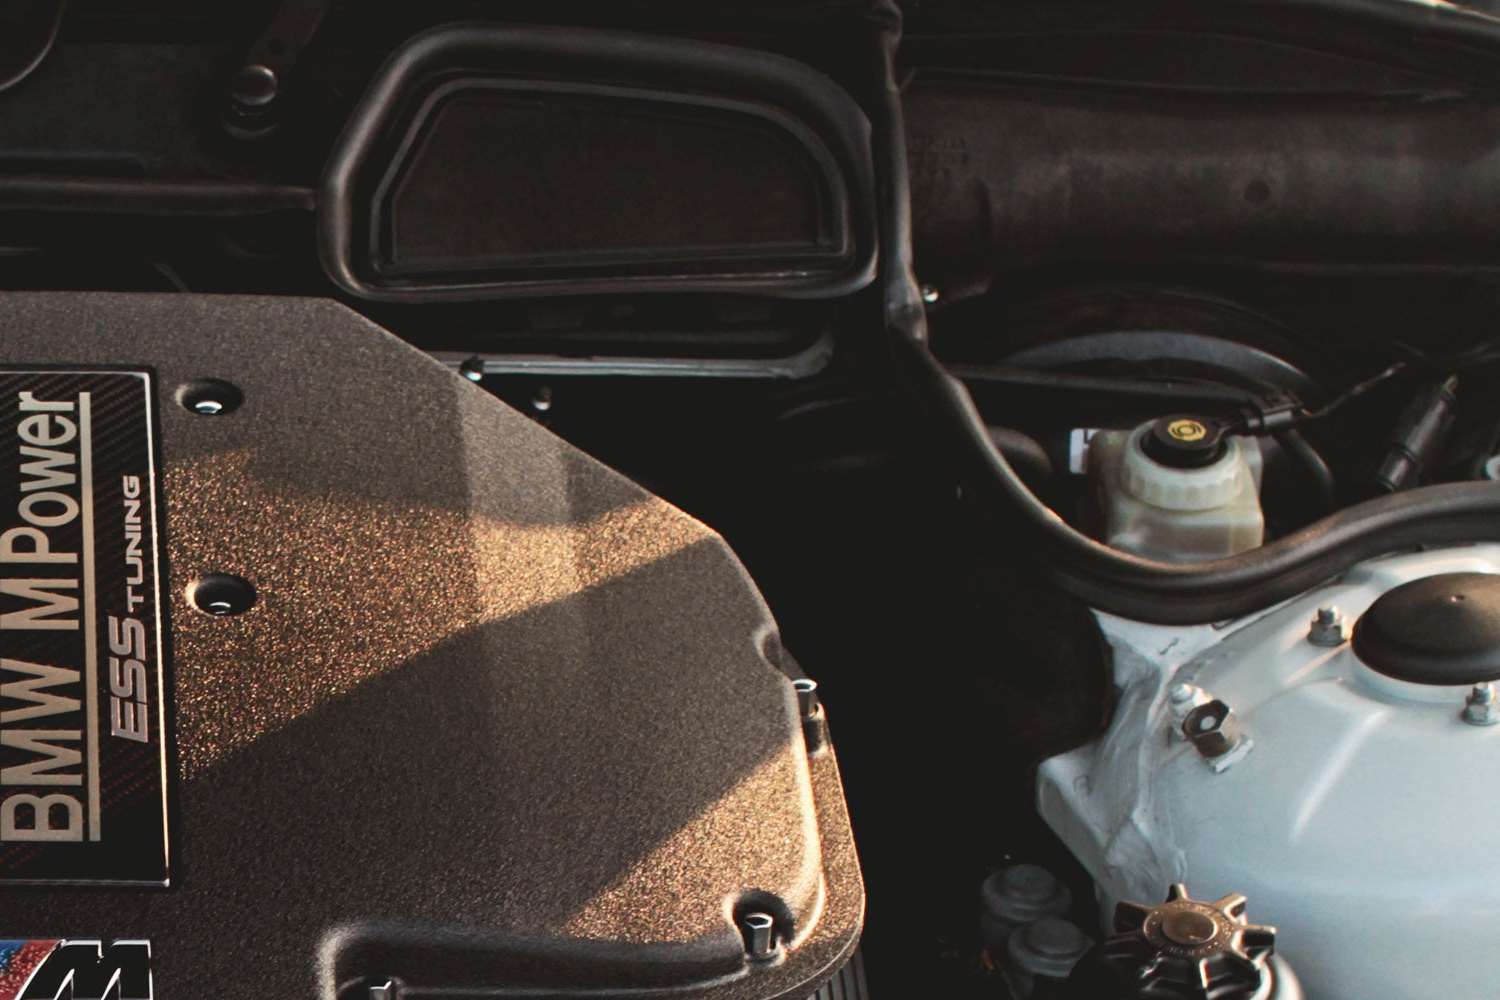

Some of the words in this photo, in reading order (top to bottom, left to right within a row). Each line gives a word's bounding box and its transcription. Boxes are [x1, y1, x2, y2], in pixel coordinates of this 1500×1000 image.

[122, 475, 145, 613] TUNING
[108, 615, 148, 743] ESS
[0, 658, 84, 842] BMW
